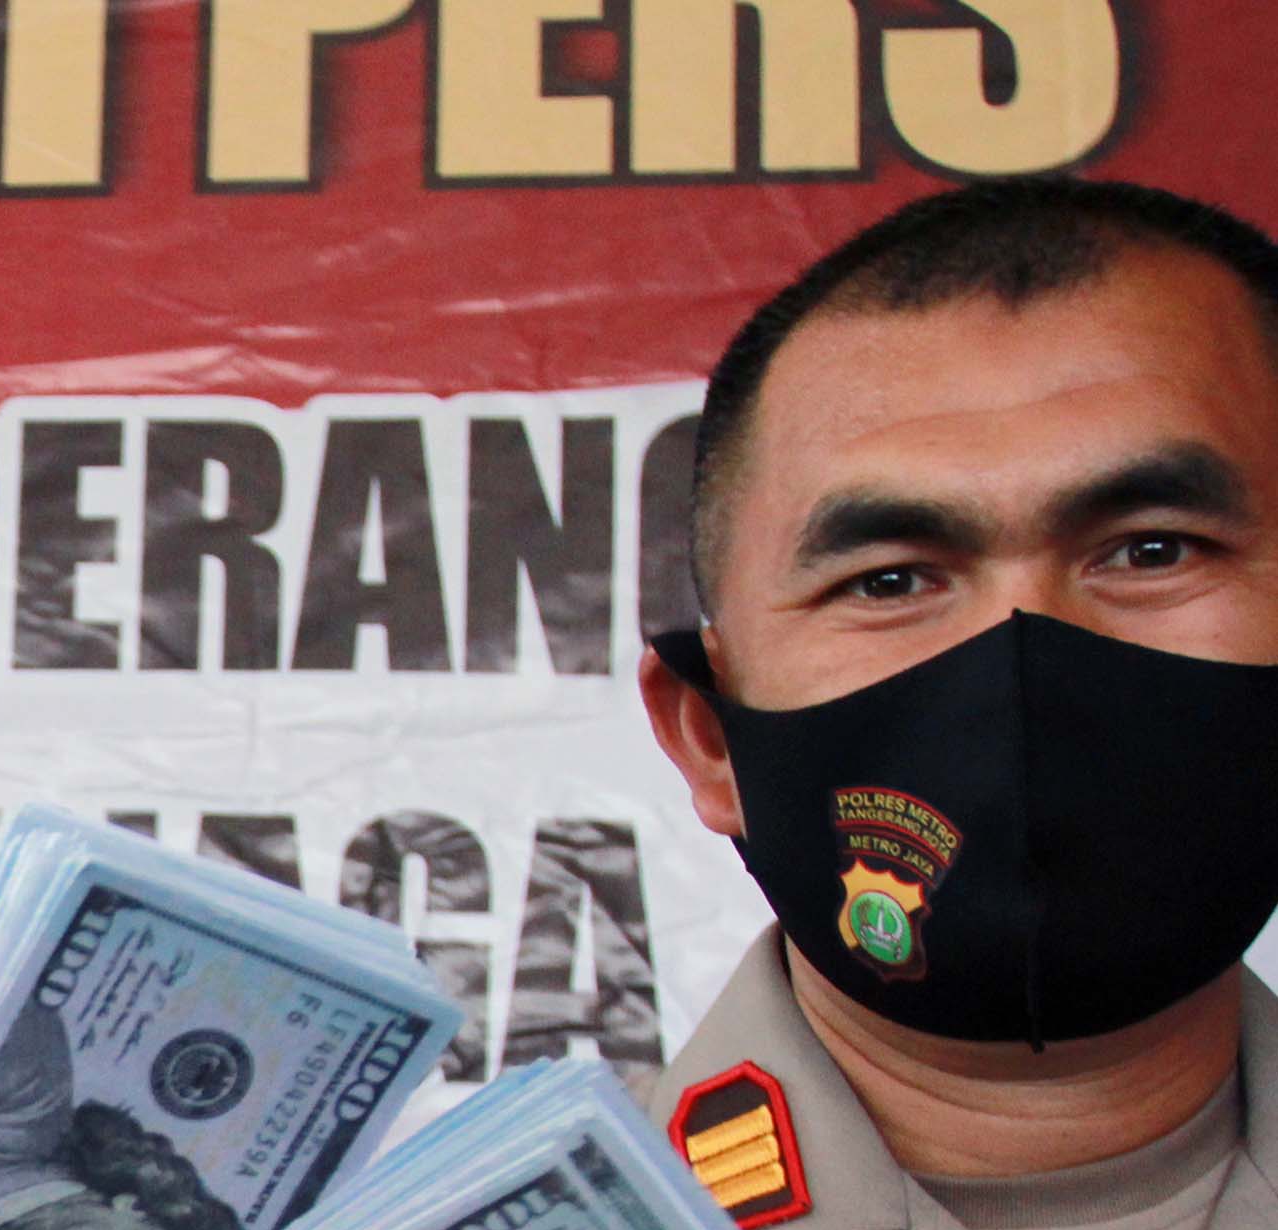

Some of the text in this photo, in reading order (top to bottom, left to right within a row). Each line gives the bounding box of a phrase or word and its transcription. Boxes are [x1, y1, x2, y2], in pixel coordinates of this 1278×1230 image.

[837, 792, 958, 849] POLRES METRO
[848, 834, 935, 877] METRO JAYA
[31, 901, 114, 1017] 100
[330, 1012, 417, 1132] 100
